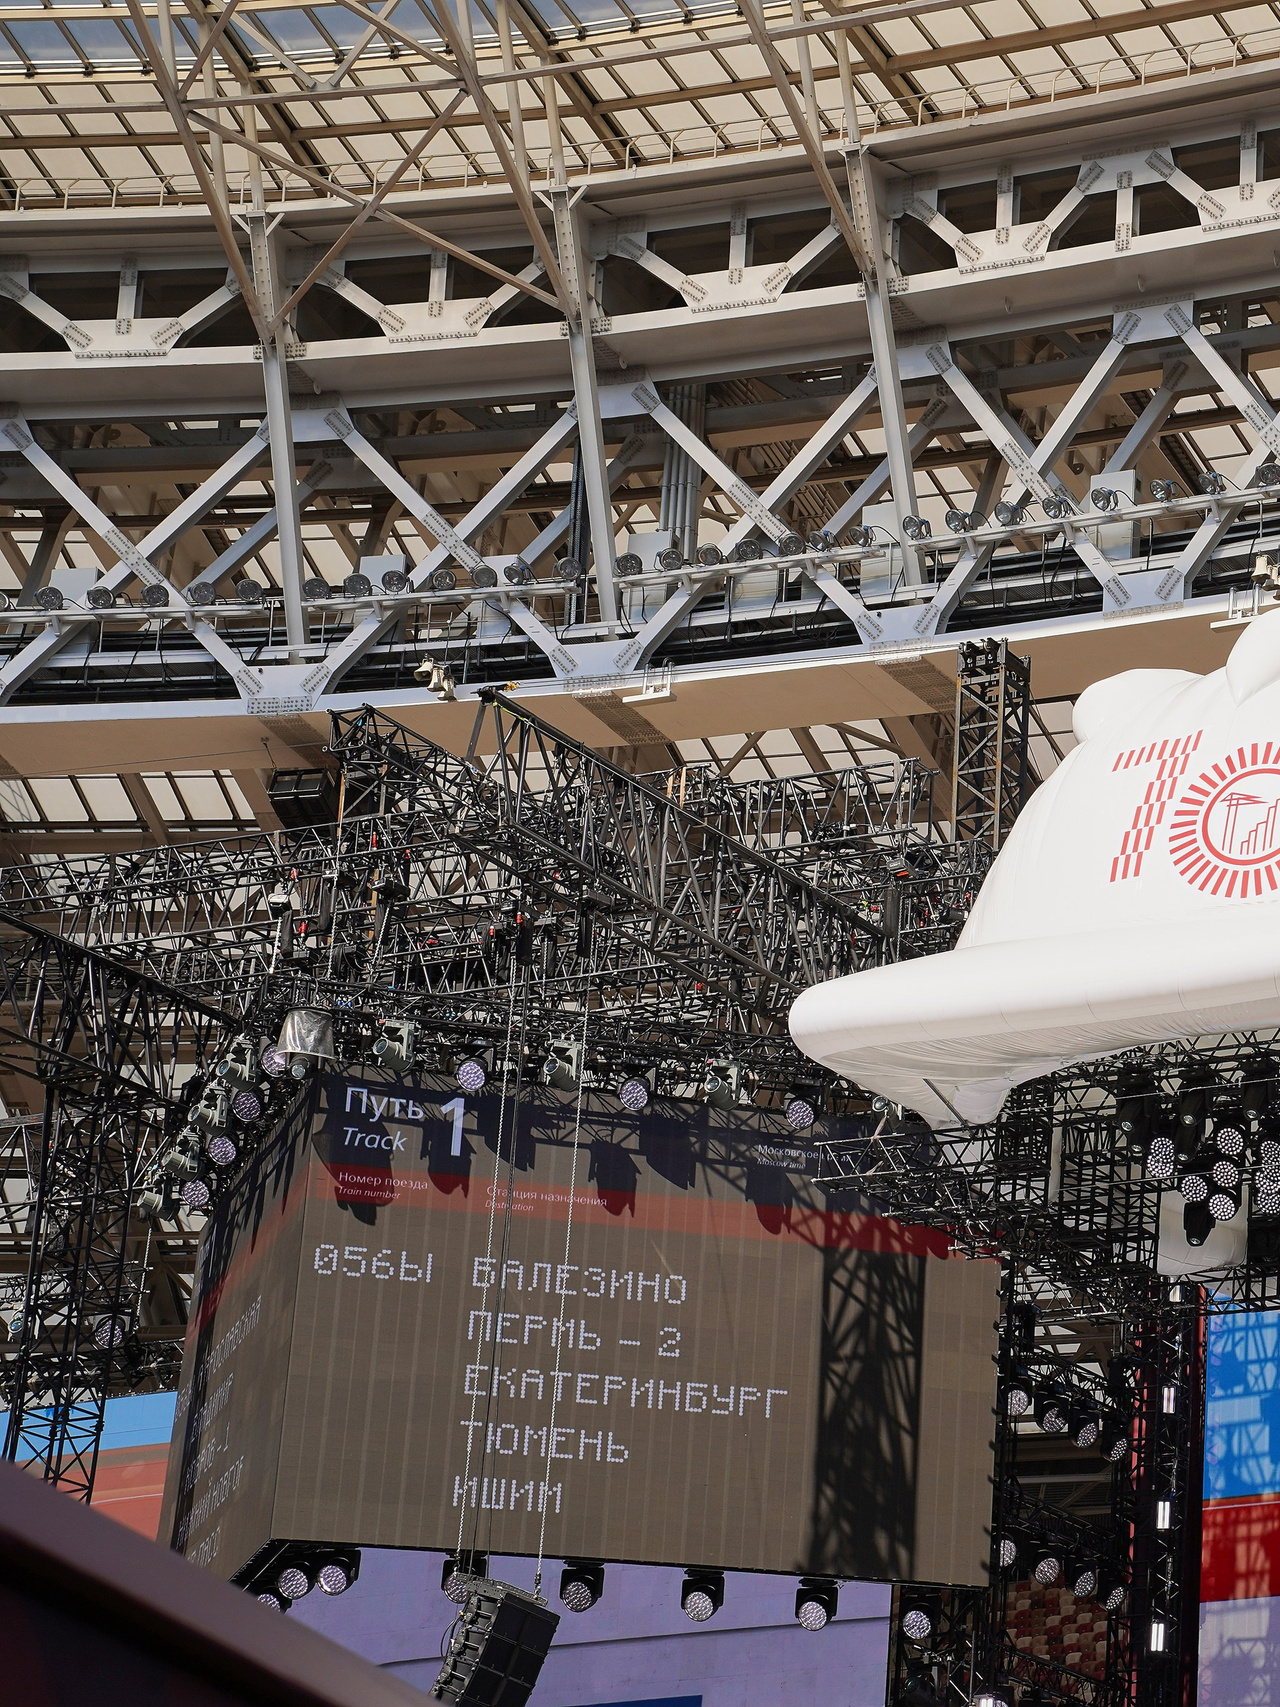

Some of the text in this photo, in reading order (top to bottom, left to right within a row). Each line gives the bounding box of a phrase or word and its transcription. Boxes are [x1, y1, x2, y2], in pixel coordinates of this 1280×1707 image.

[345, 1087, 465, 1157] Путь 1
[343, 1127, 408, 1152] Track
[757, 1144, 818, 1160] Московское
[756, 1157, 806, 1169] Moscow time
[338, 1185, 400, 1199] Train number
[339, 1172, 428, 1190] Номер поезда
[485, 1200, 534, 1211] Dstiation
[540, 1193, 607, 1206] назначения
[314, 1244, 433, 1283] 056Ы
[472, 1257, 687, 1305] БАЛЕЗИНО
[467, 1310, 601, 1351] ПЕРМЬ
[657, 1327, 681, 1358] 2
[463, 1364, 788, 1419] ЕКАТЕРИНБУРГ
[460, 1420, 629, 1464] ТЮМЕНЬ
[452, 1475, 562, 1514] ИШИМ
